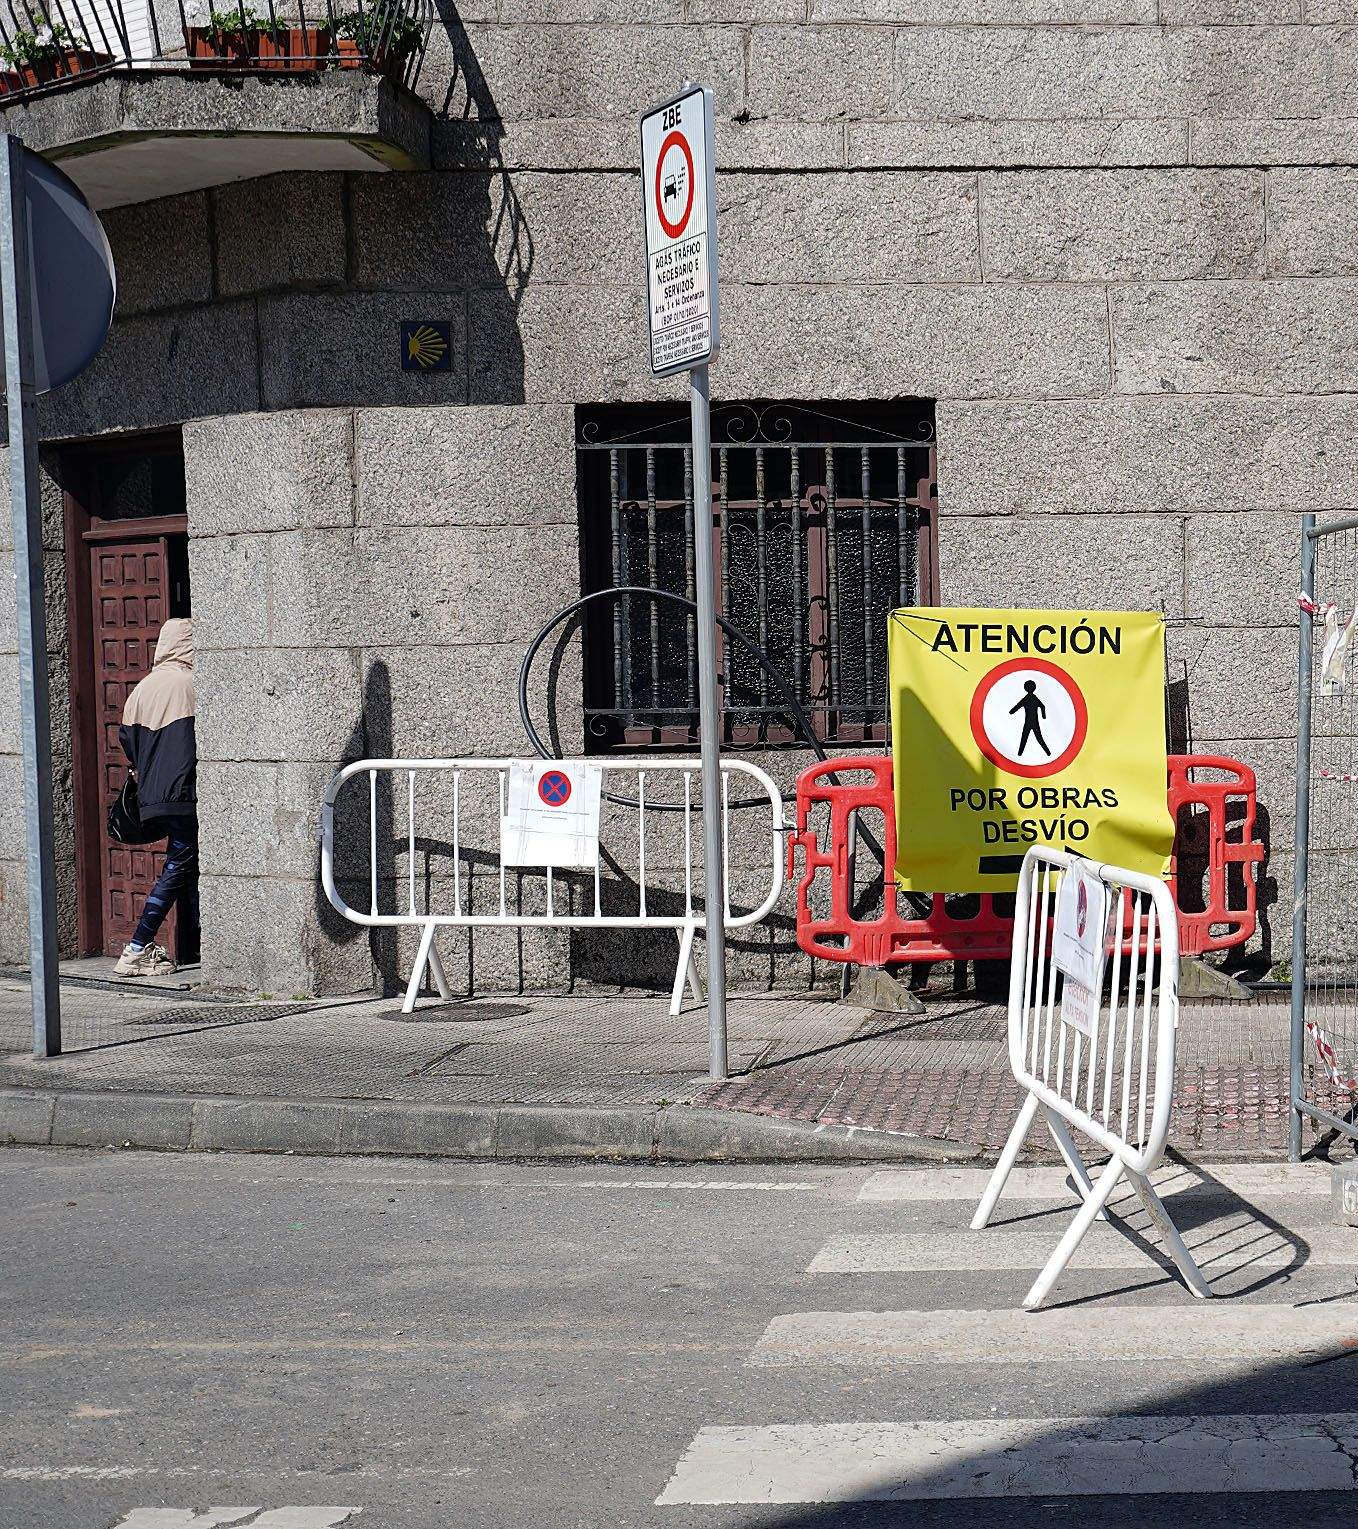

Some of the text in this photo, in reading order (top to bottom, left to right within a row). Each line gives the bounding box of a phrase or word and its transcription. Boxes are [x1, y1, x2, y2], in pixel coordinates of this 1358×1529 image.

[662, 103, 682, 132] ZBE
[674, 241, 701, 262] TRÁFICO
[657, 258, 699, 285] NECESARIO E
[664, 277, 695, 299] SERVIZOS
[931, 618, 1121, 655] ATENCIÓN
[950, 786, 1119, 812] POR OBRAS
[983, 814, 1090, 844] DESVÍO
